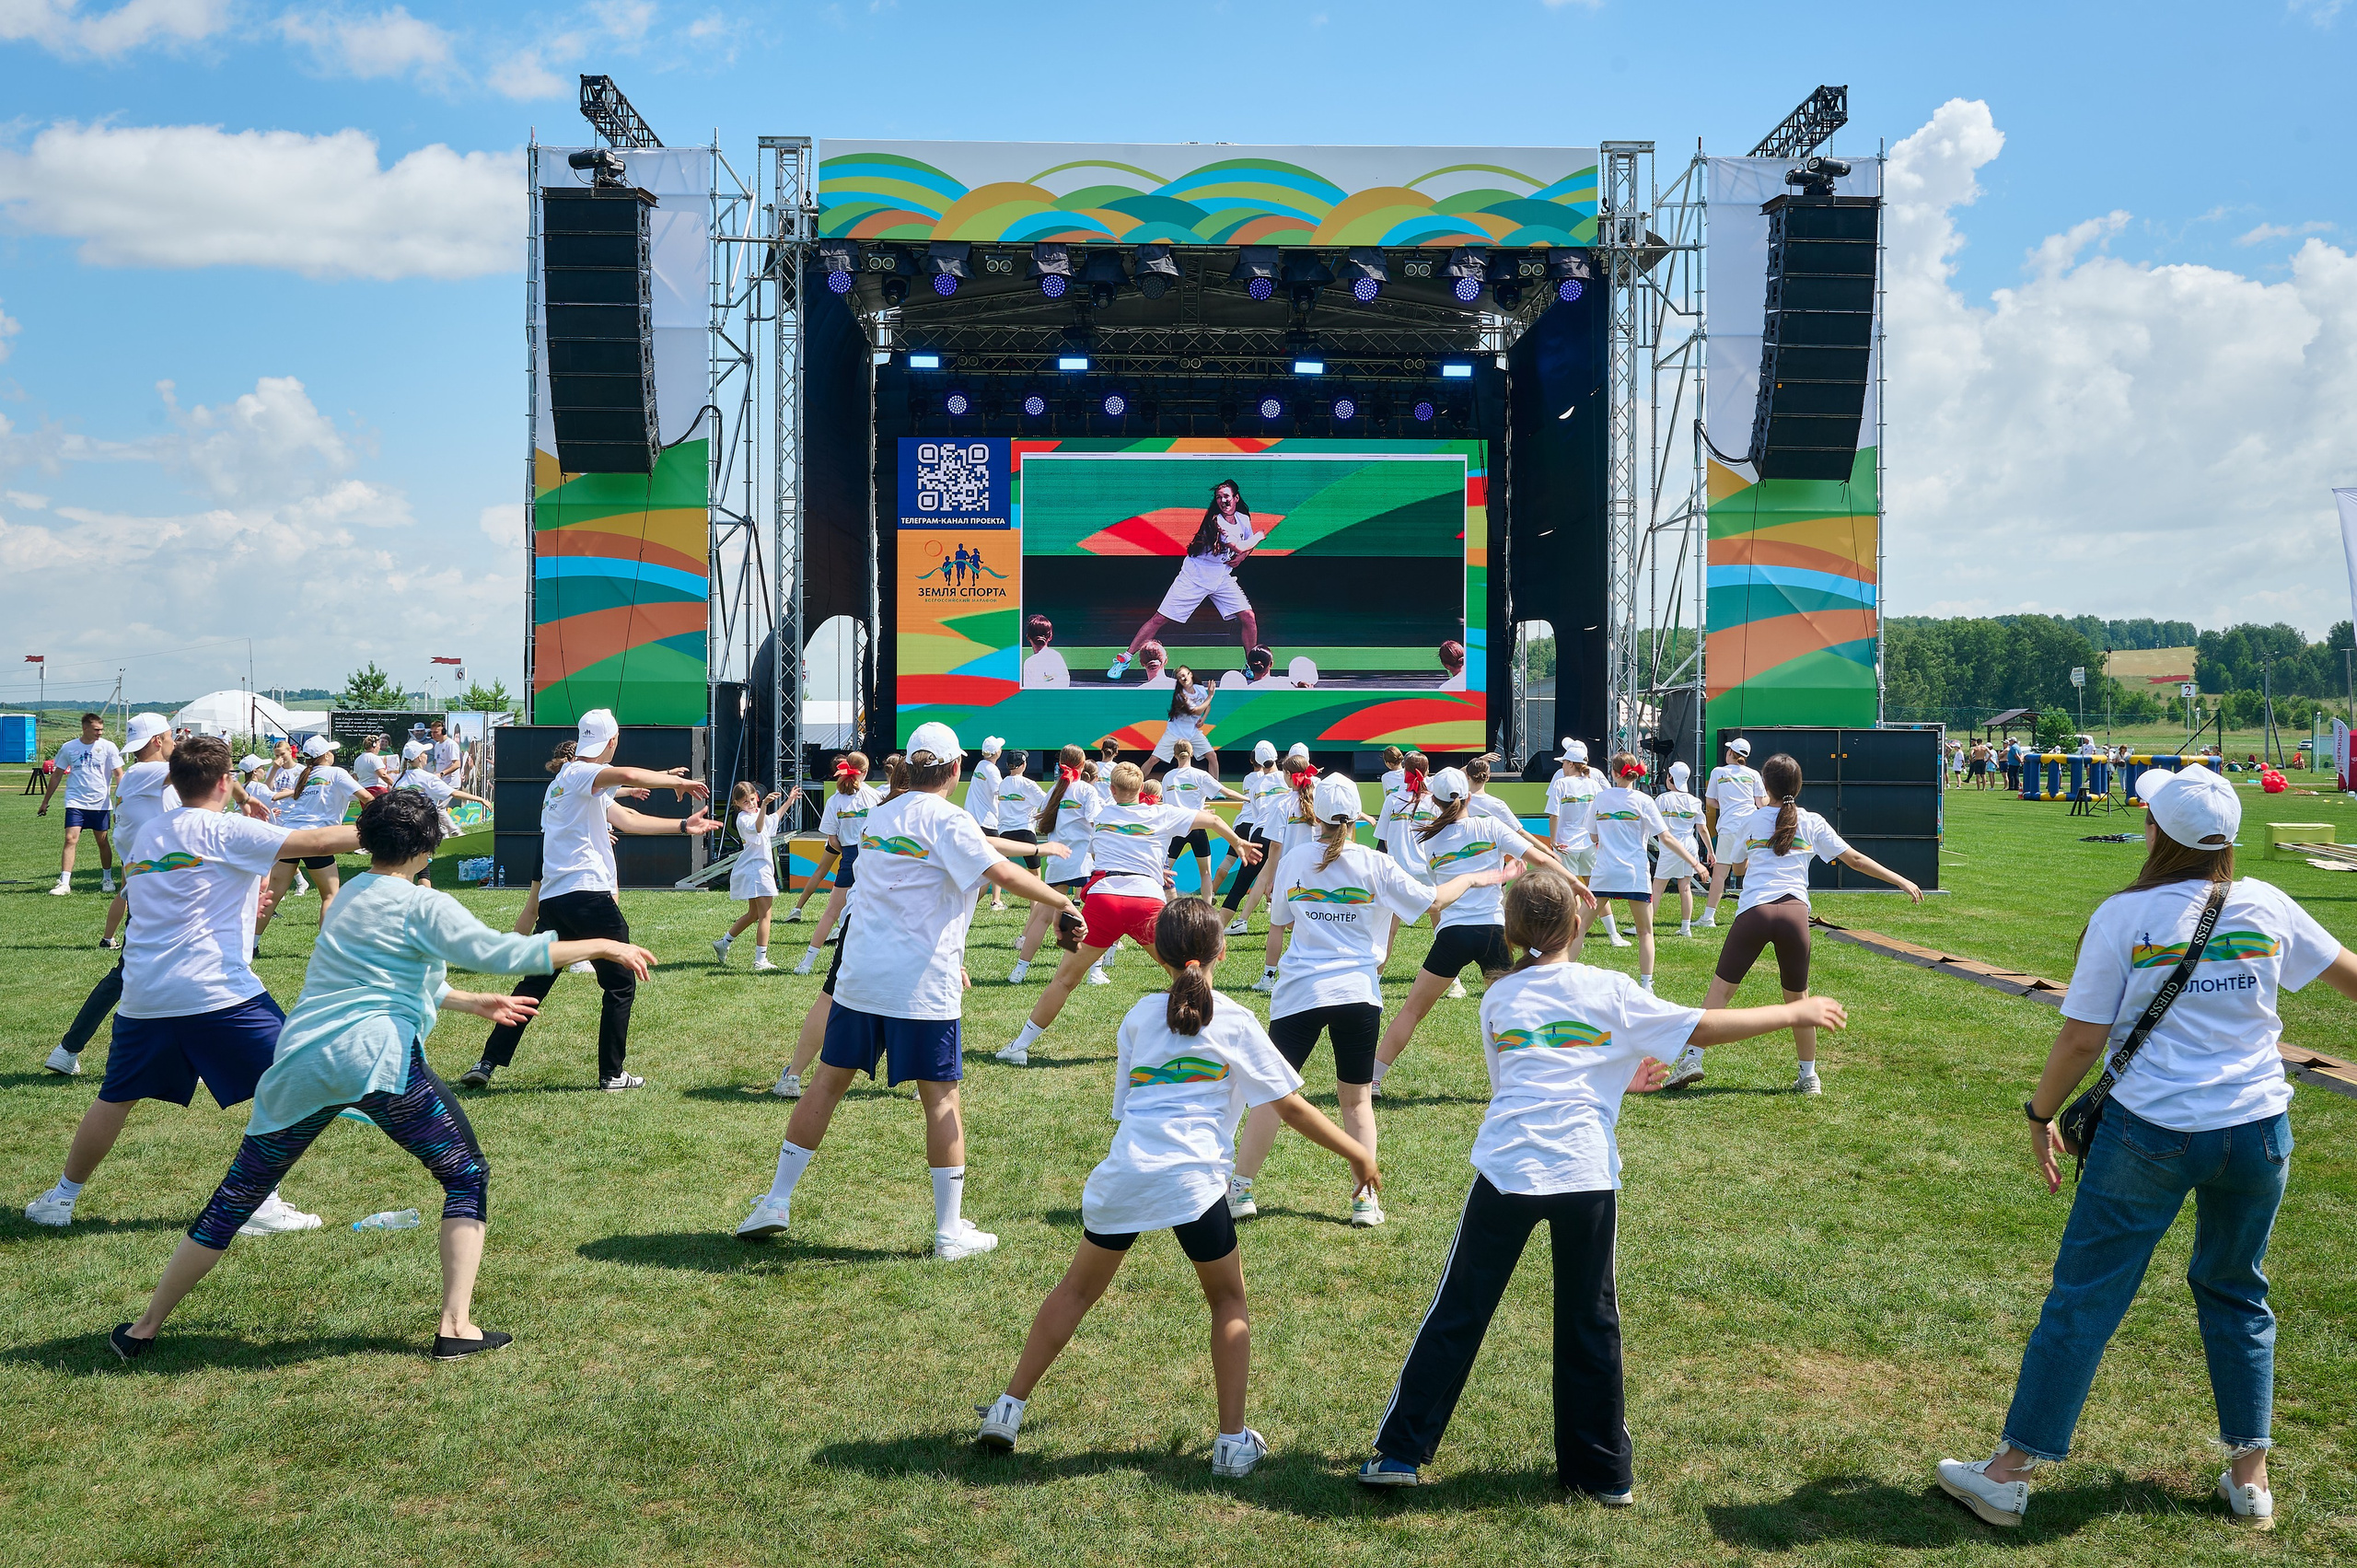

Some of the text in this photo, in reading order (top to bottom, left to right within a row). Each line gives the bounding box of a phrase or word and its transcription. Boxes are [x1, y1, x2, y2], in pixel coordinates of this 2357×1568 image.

[900, 517, 1005, 525] ТЕЛЕГРАМ-КАНАЛ ПРОЕКТА
[918, 587, 1007, 597] ЗЕМЛЯ СПОРТА
[457, 668, 464, 679] 6
[2184, 685, 2191, 696] 2
[1305, 911, 1357, 923] ВОЛОНТЁР
[2194, 908, 2217, 947] GUESS
[2163, 973, 2258, 993] ЛОНТЁР
[2148, 981, 2179, 1018] GUESS
[2091, 1074, 2112, 1104] UESS
[2016, 1483, 2025, 1498] LOVE
[2247, 1486, 2255, 1500] LOVE
